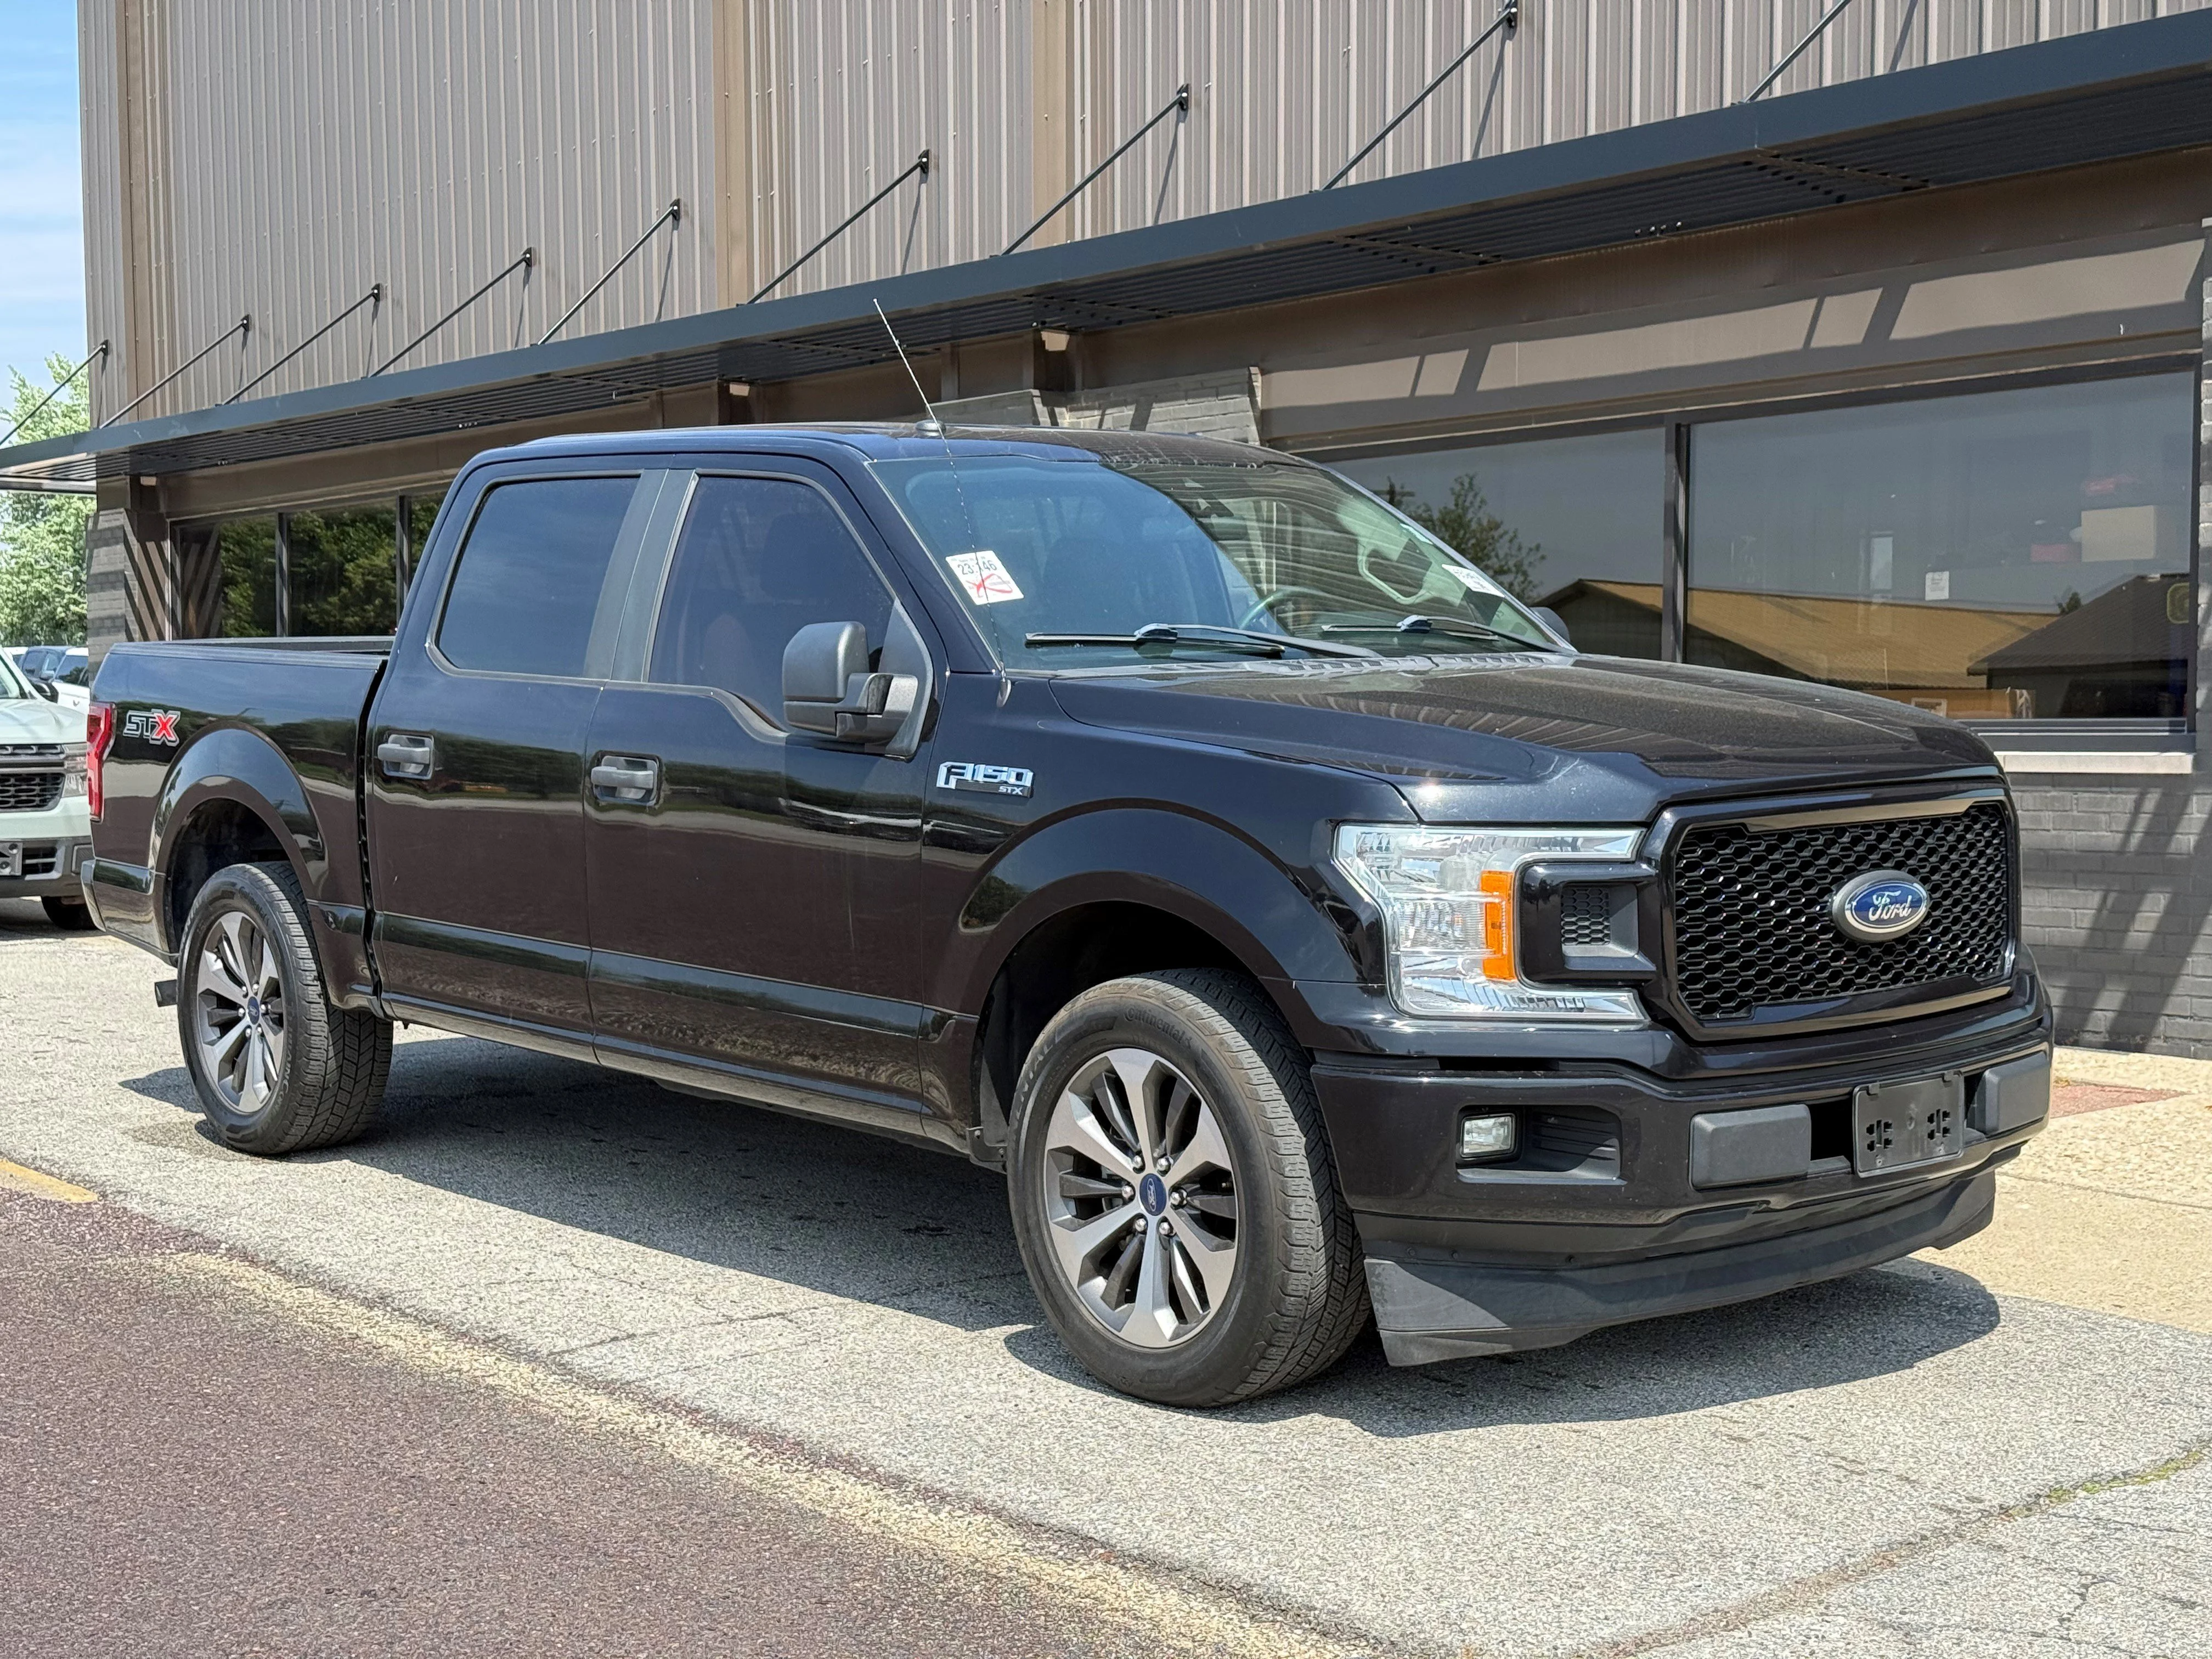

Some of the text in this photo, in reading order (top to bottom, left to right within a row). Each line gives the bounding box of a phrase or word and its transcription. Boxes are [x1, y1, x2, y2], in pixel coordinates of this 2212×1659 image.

[122, 708, 181, 747] STX
[998, 785, 1024, 796] STX
[1868, 890, 1912, 922] Ford
